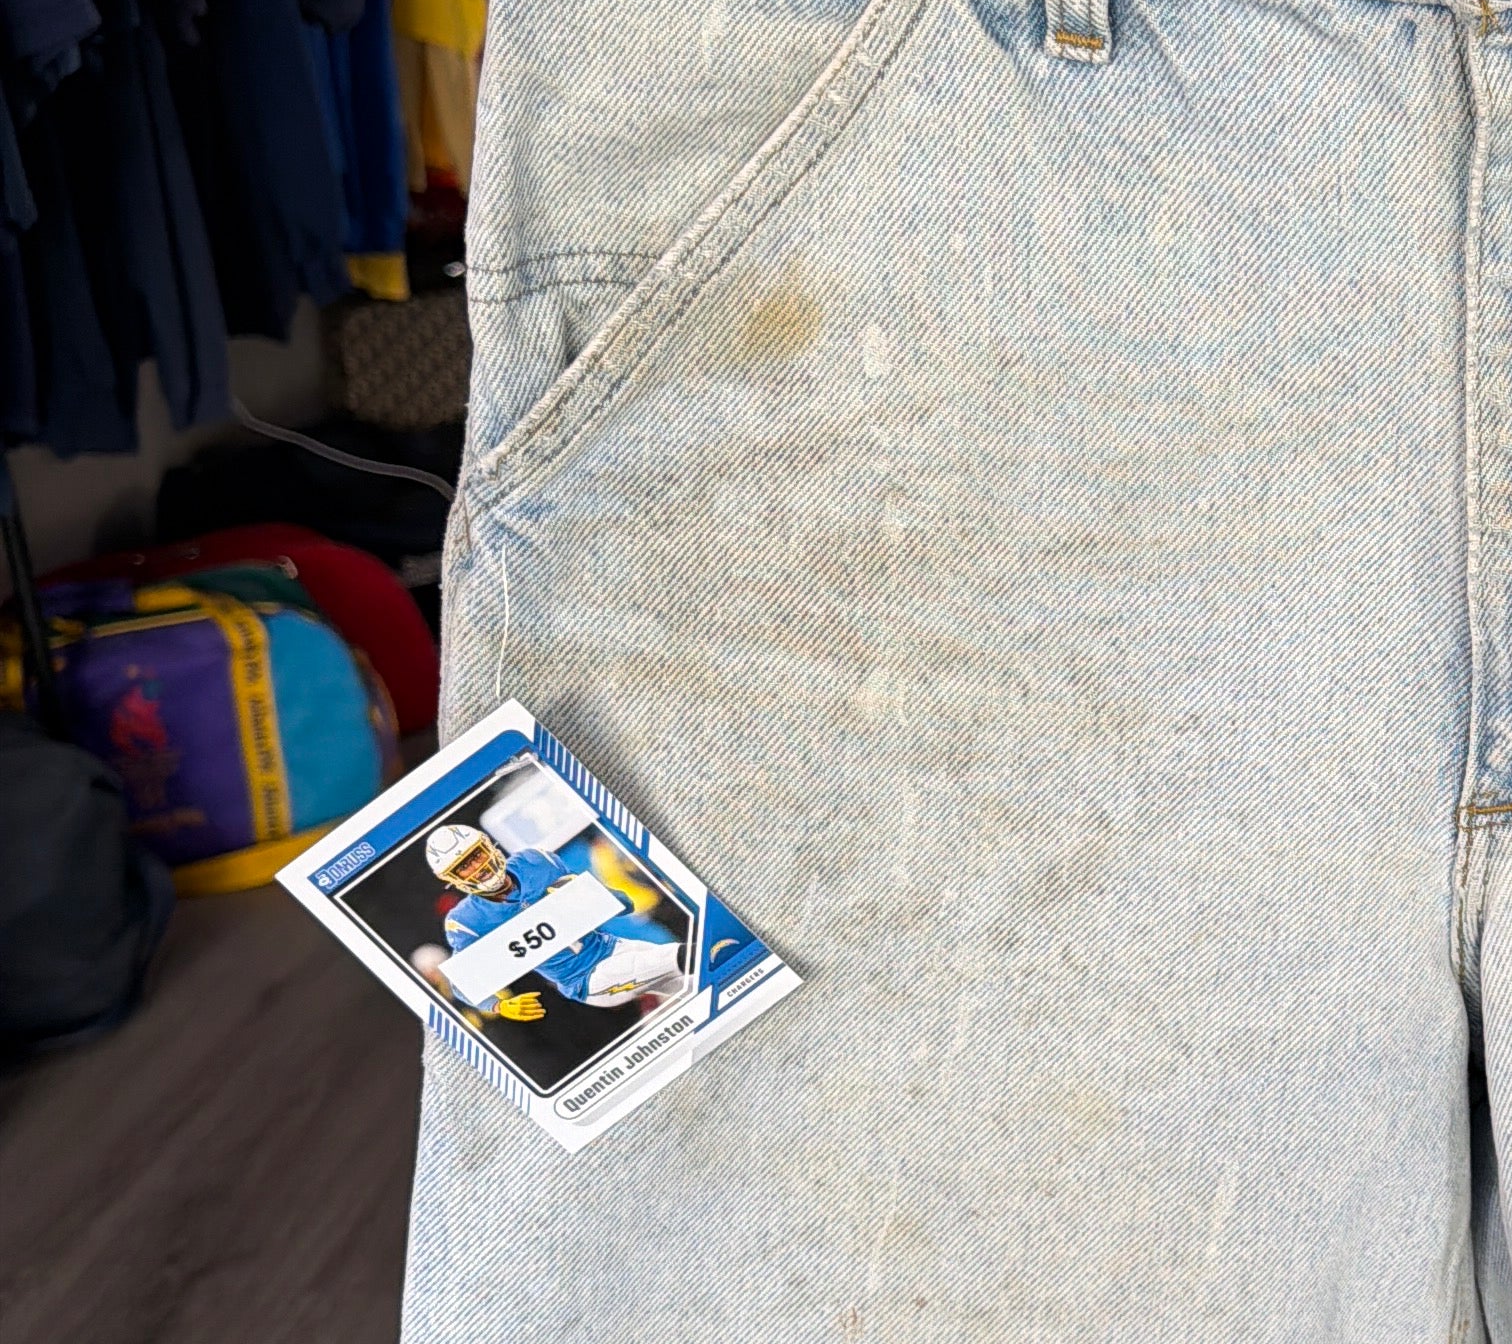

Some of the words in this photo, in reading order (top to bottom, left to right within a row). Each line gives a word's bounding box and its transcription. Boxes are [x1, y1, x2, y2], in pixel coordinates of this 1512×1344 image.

[508, 922, 556, 958] $50
[726, 968, 765, 998] CHARGERS
[563, 1065, 625, 1113] Quentin
[625, 1014, 695, 1069] Johnston
